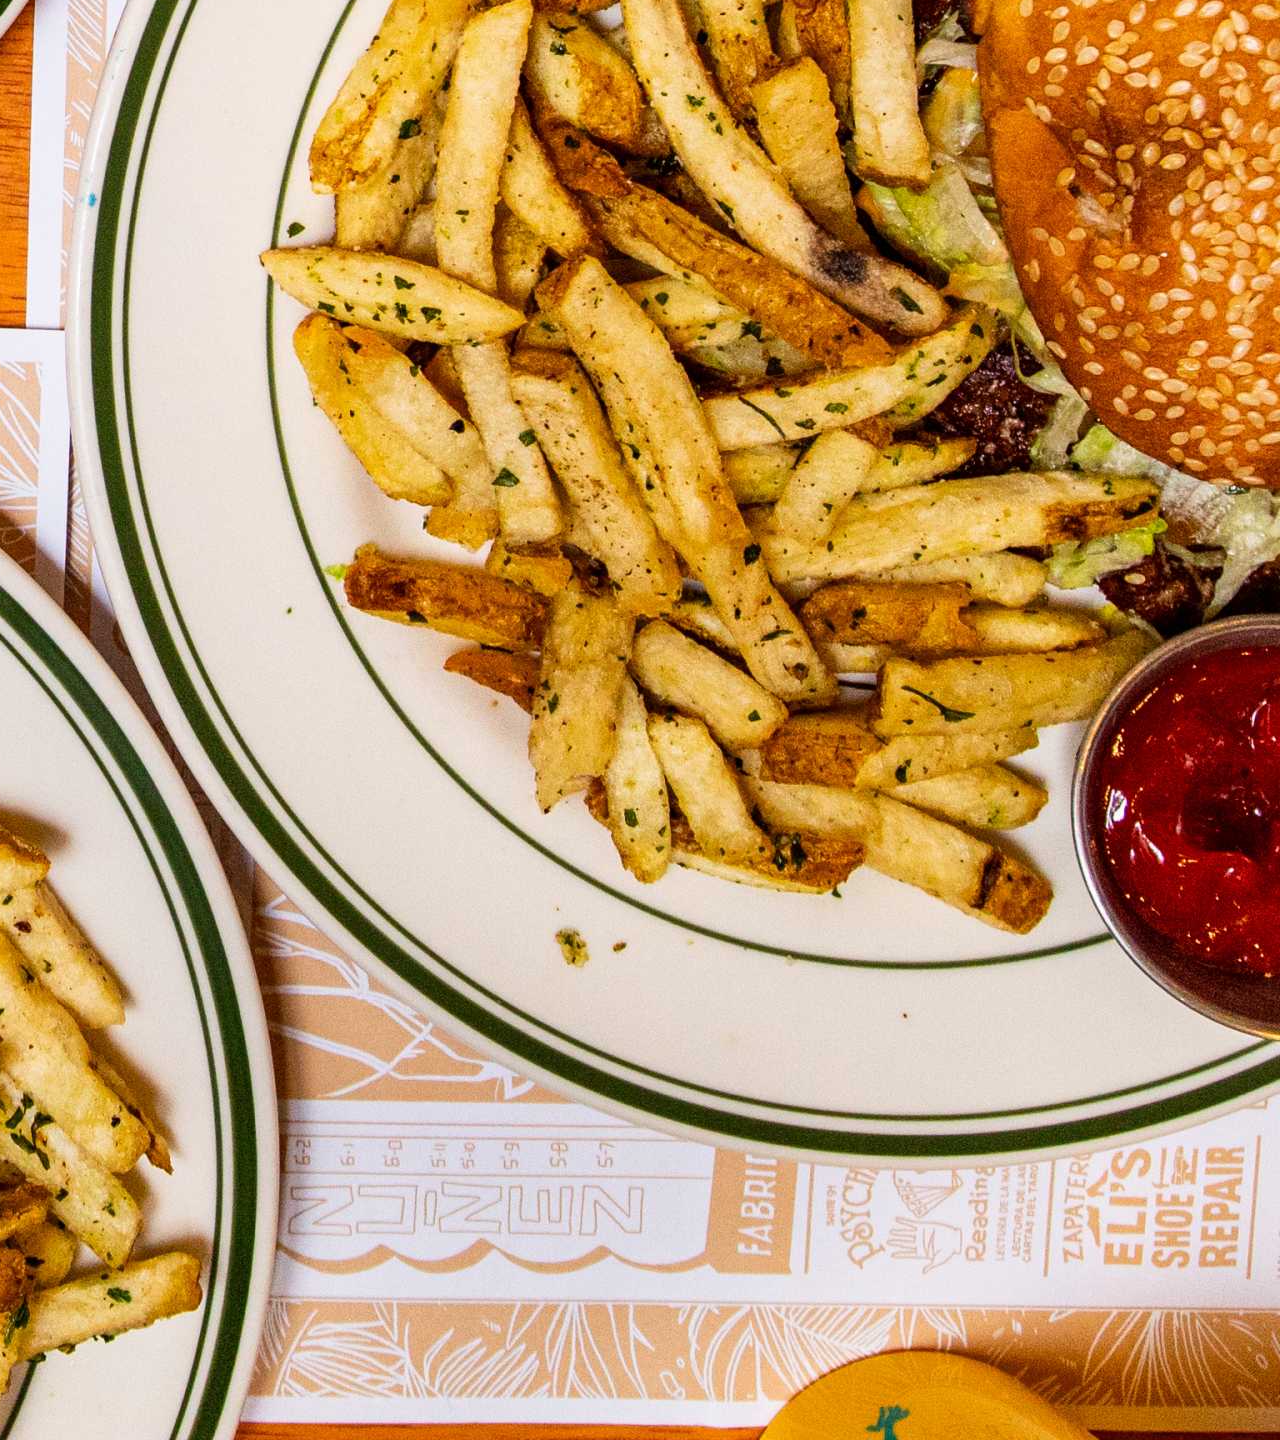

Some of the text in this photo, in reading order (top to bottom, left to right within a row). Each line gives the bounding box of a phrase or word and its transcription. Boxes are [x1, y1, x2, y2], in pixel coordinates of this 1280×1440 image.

[1011, 1207, 1024, 1258] LECTURA
[1015, 1190, 1025, 1204] DE
[1022, 1165, 1039, 1264] CARTAS DEL TARO
[1103, 1148, 1152, 1266] ELI'S
[1150, 1192, 1194, 1270] SHOE
[1197, 1146, 1245, 1269] REPAIR
[994, 1217, 1007, 1262] LECTURA
